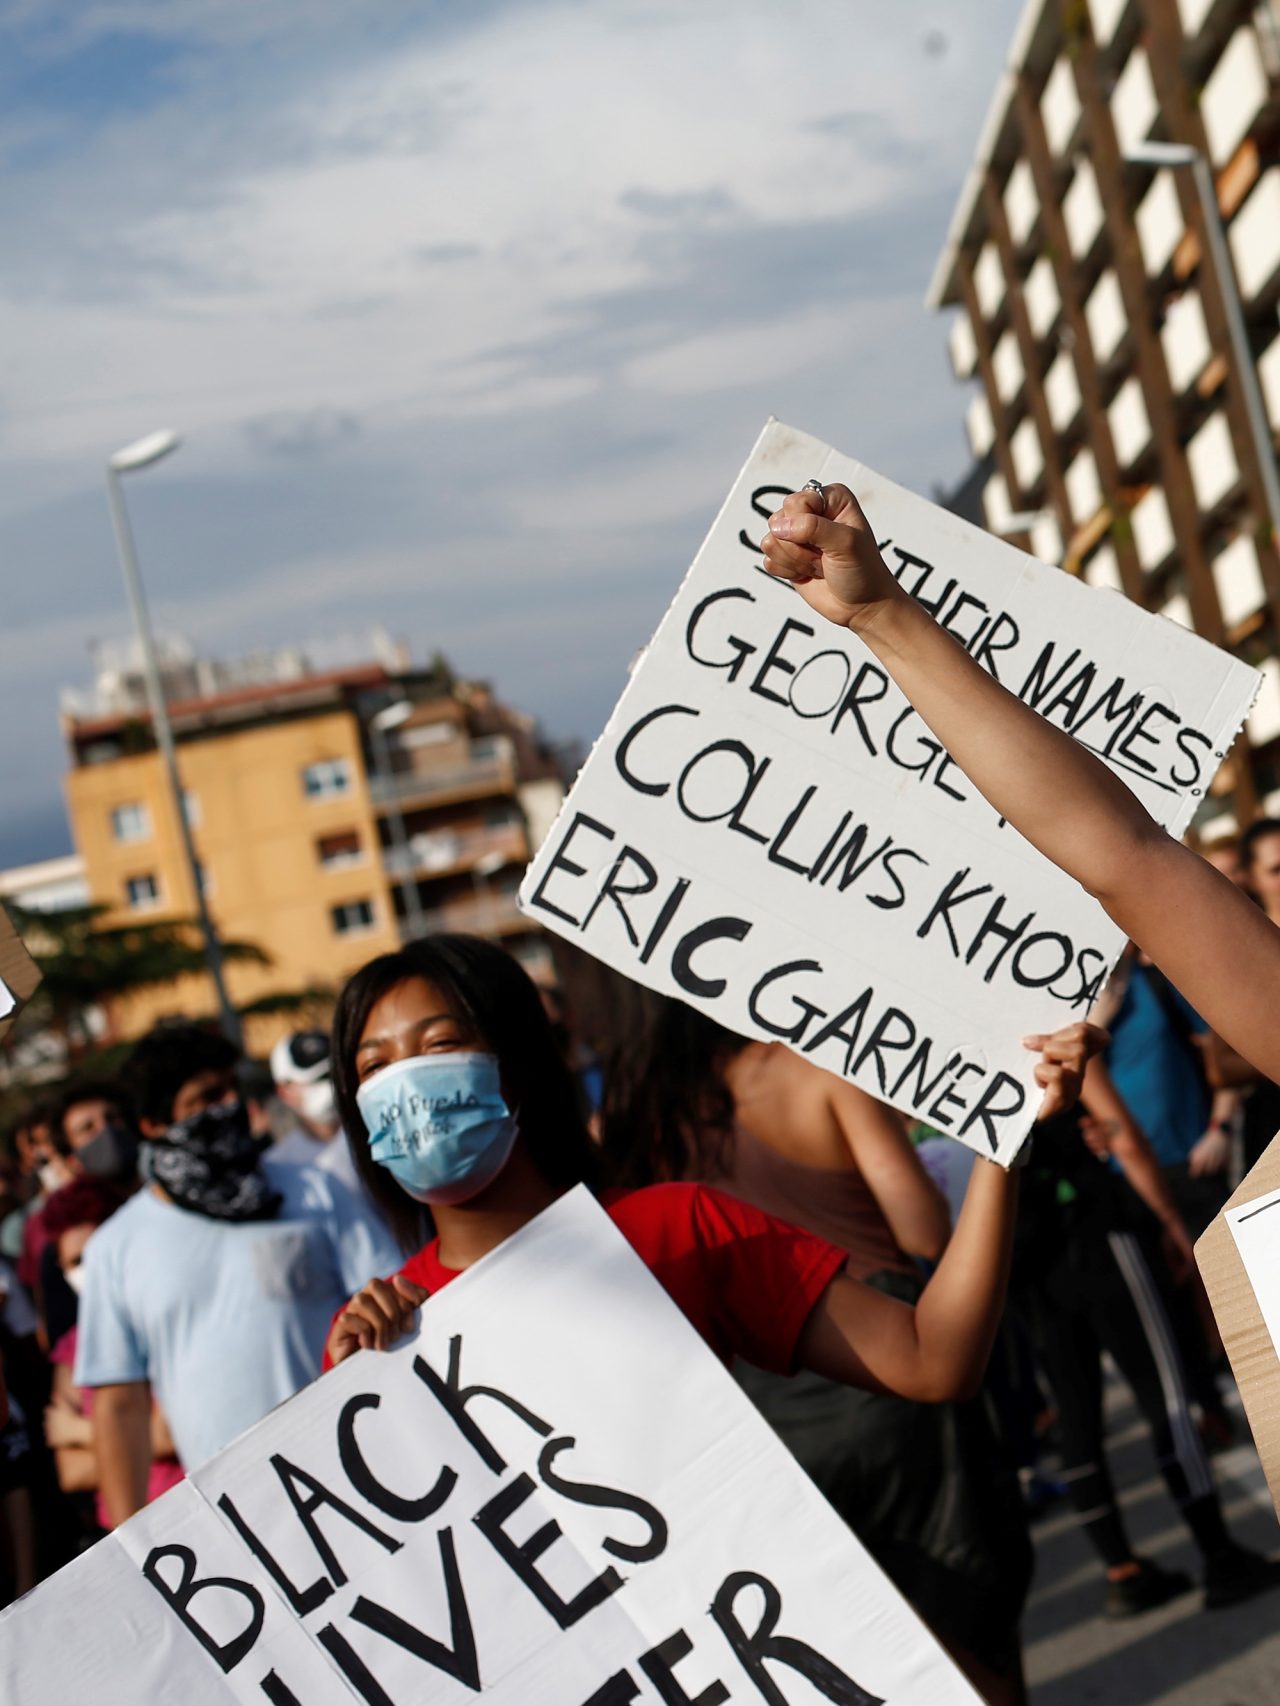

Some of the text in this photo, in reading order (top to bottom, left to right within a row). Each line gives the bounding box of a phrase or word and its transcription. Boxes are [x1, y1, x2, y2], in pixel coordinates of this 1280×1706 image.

[530, 811, 1025, 1154] ERIC GARNER
[614, 705, 1109, 1021] COLLINS KHOSA
[142, 1333, 555, 1674] BLACK
